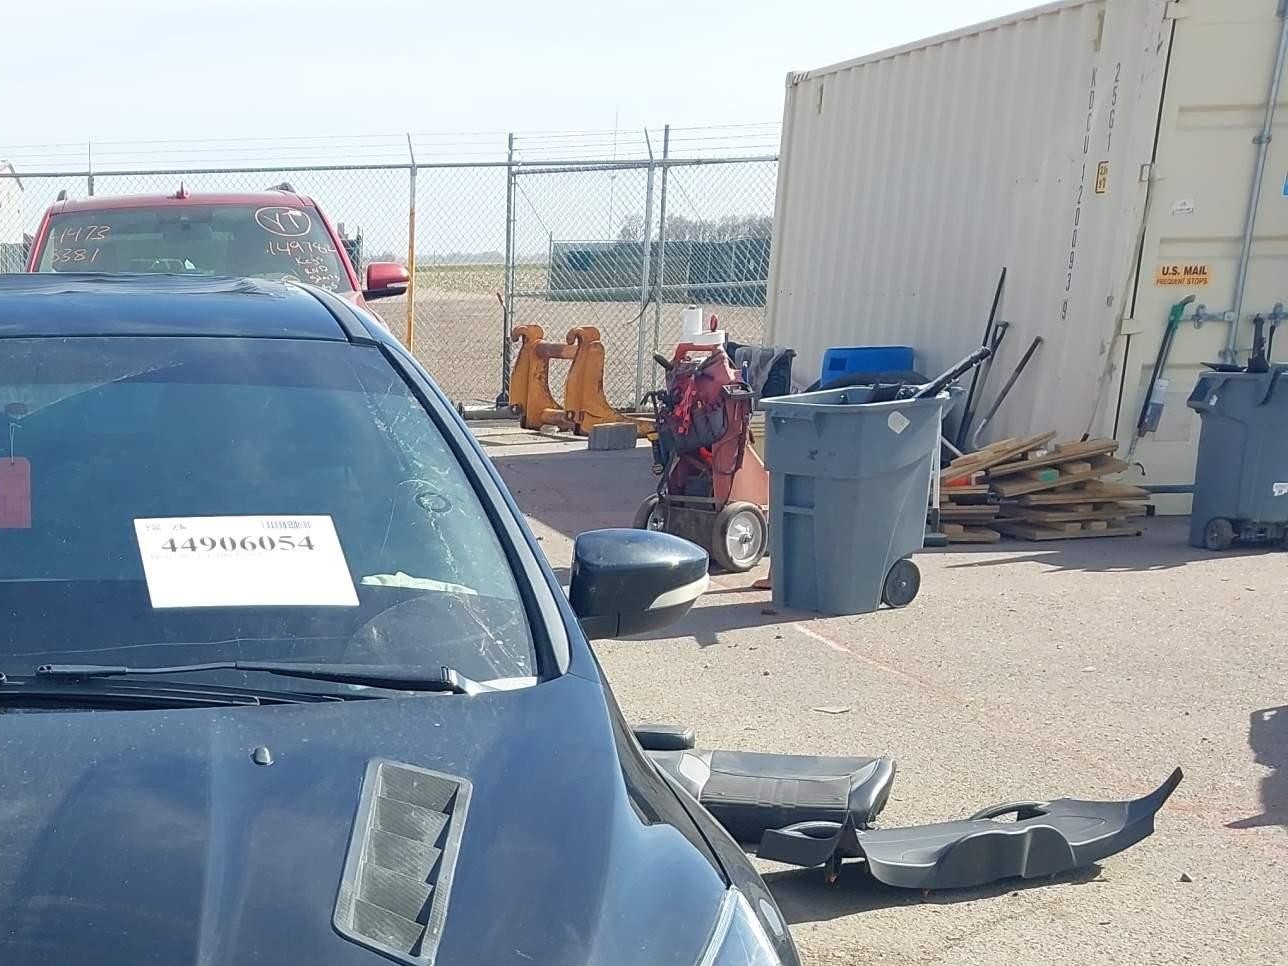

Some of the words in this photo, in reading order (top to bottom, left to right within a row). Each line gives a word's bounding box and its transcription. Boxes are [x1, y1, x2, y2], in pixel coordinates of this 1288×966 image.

[1162, 266, 1180, 275] U.S.
[1184, 266, 1207, 275] MAIL
[1186, 277, 1208, 285] STOPS
[161, 535, 315, 553] 44906054
